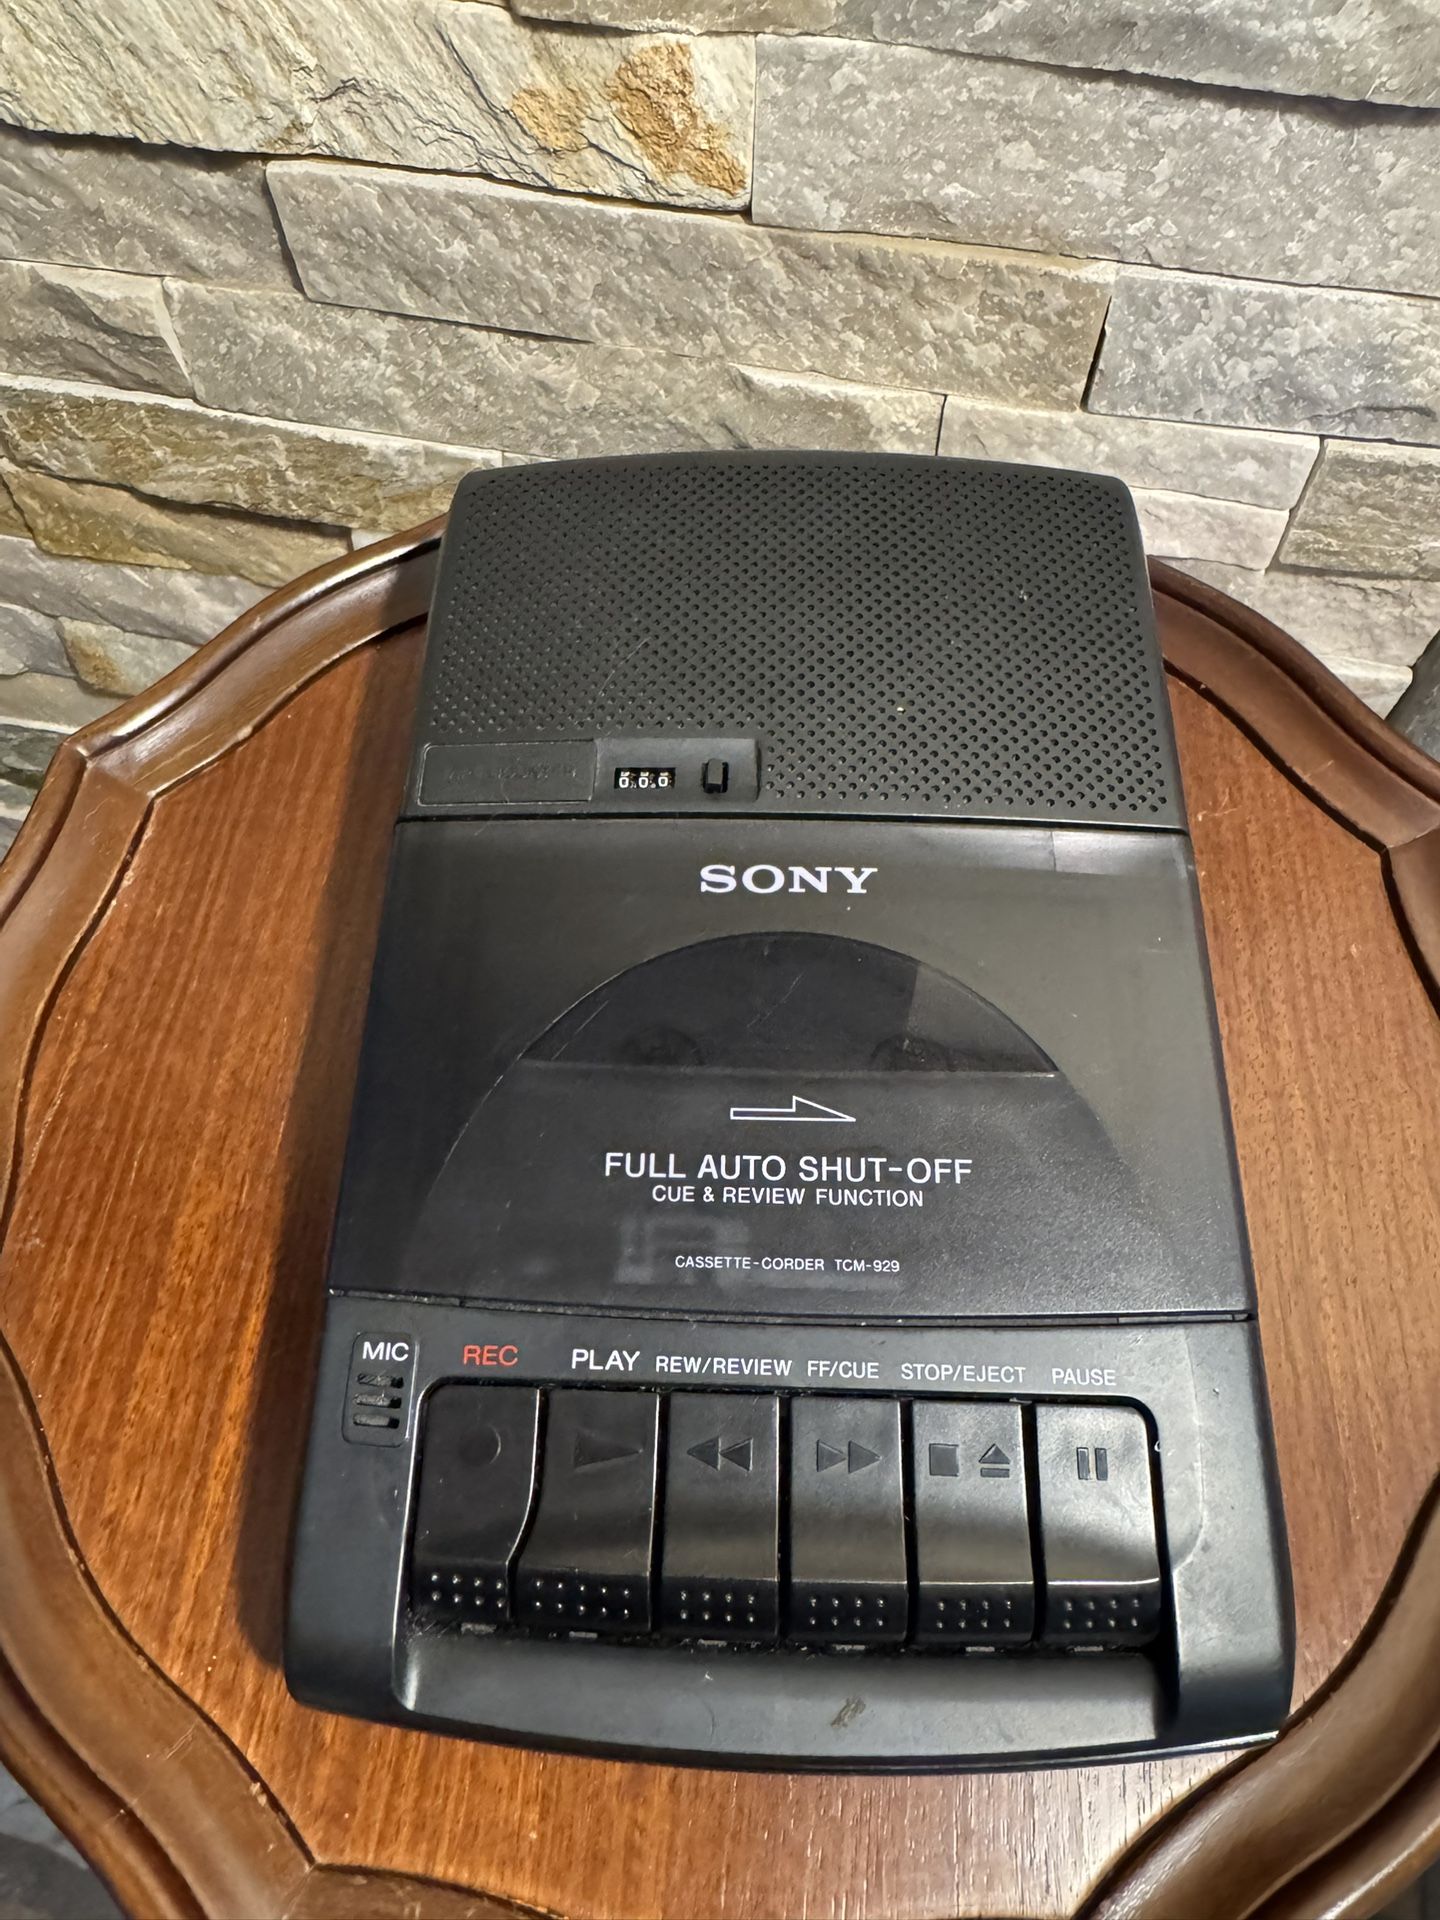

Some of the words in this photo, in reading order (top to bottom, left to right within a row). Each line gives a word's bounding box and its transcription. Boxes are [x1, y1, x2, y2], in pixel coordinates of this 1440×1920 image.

[700, 864, 878, 893] SONY
[605, 1152, 686, 1179] FULL
[697, 1154, 786, 1181] AUTO
[798, 1156, 973, 1184] SHUT-OFF
[652, 1184, 695, 1203] CUE
[703, 1186, 715, 1203] &
[722, 1186, 806, 1205] REVIEW
[816, 1188, 923, 1208] FUNCTION
[675, 1255, 824, 1272] CASSETTE-CORDER
[834, 1258, 900, 1273] TCM-929
[362, 1341, 409, 1362] MIC
[463, 1345, 519, 1366] REC
[571, 1348, 641, 1372] PLAY
[655, 1355, 793, 1377] REW/REVIEW
[807, 1360, 880, 1379] FF/CUE
[901, 1363, 1027, 1384] STOP/EJECT
[1051, 1368, 1117, 1387] PAUSE
